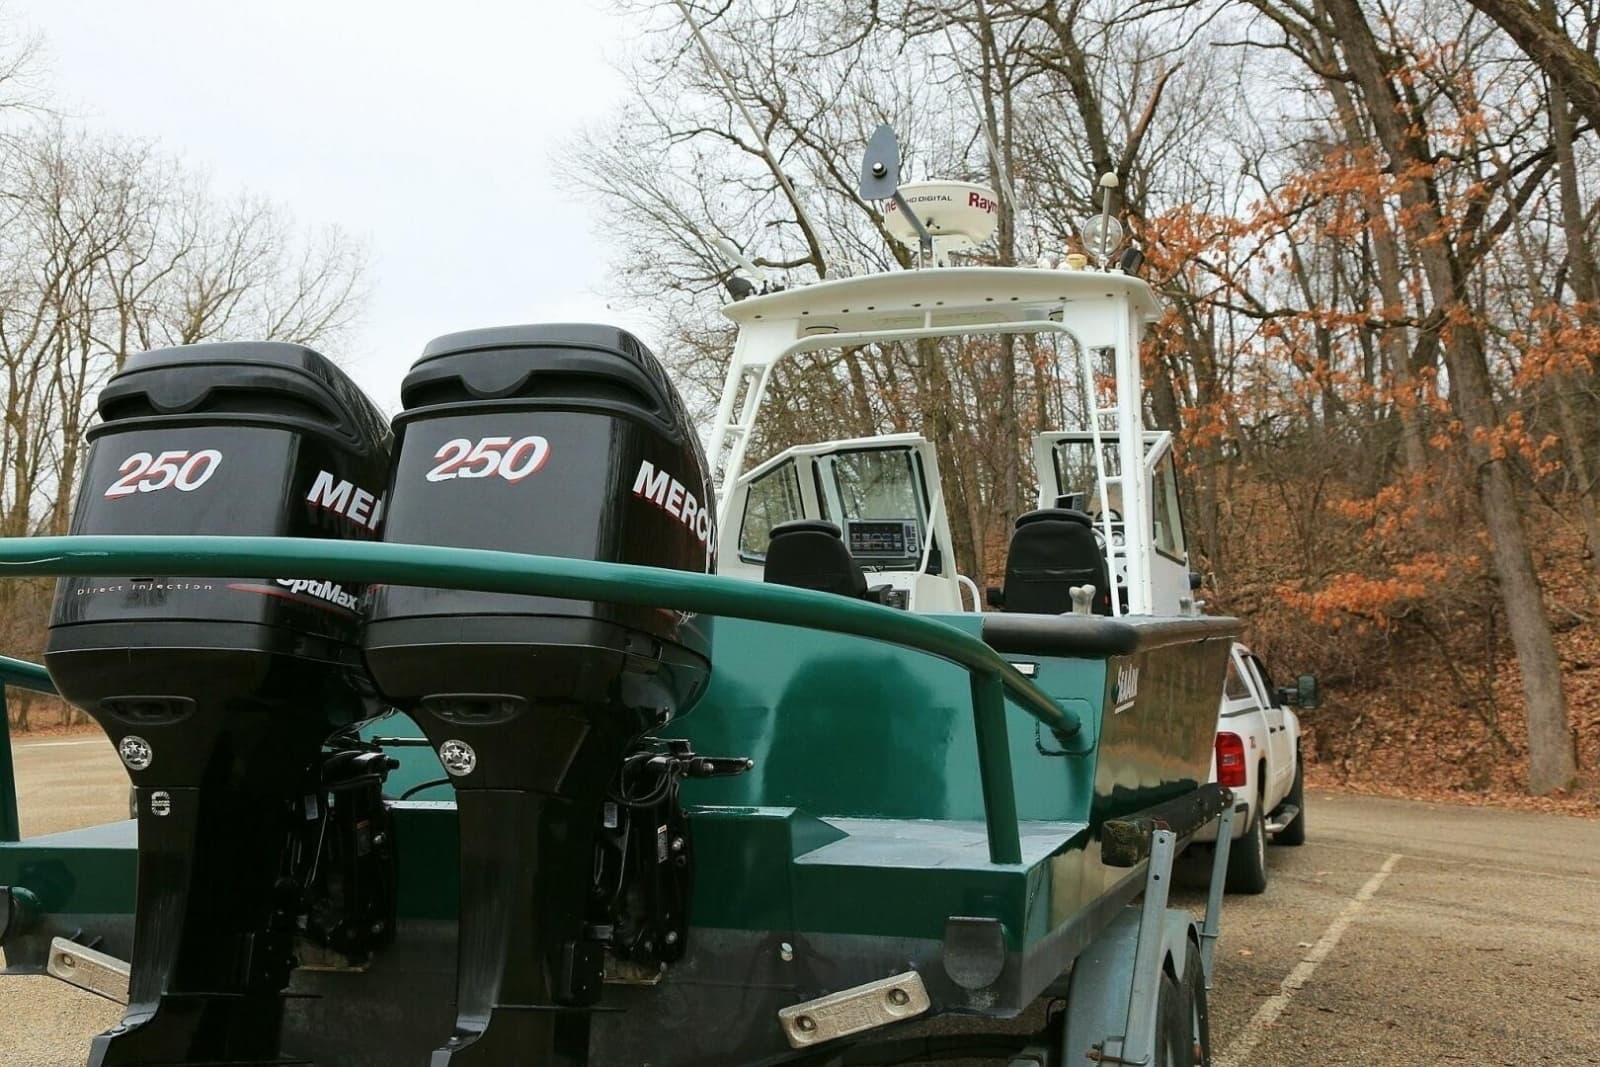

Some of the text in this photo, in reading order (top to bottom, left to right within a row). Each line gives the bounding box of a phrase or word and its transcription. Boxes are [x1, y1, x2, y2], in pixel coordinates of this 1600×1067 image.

[918, 194, 953, 203] DIGITAL
[104, 449, 223, 498] 250
[425, 435, 551, 485] 250
[77, 584, 124, 596] Direct
